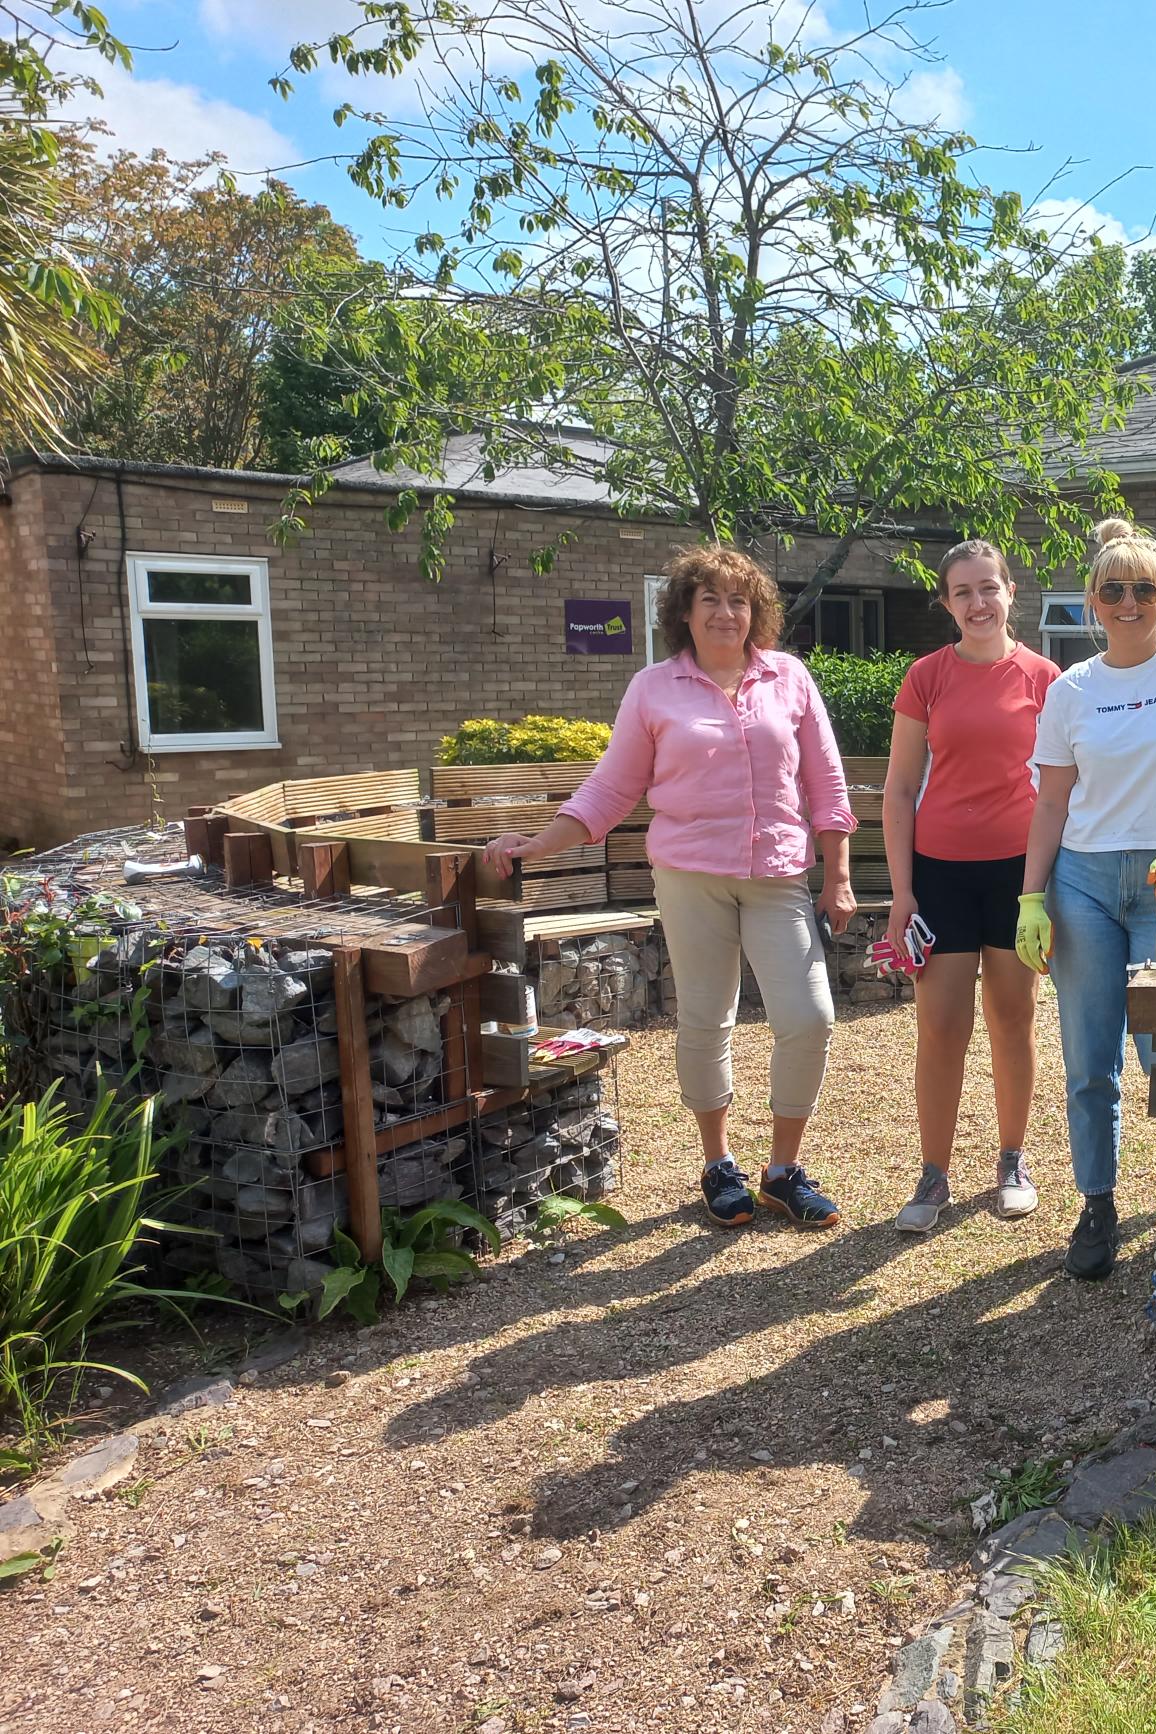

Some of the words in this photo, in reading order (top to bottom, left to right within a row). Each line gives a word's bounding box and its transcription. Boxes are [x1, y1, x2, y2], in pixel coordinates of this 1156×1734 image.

[570, 623, 604, 632] Papworth
[607, 623, 622, 631] Trust
[1096, 704, 1126, 714] TOMMY
